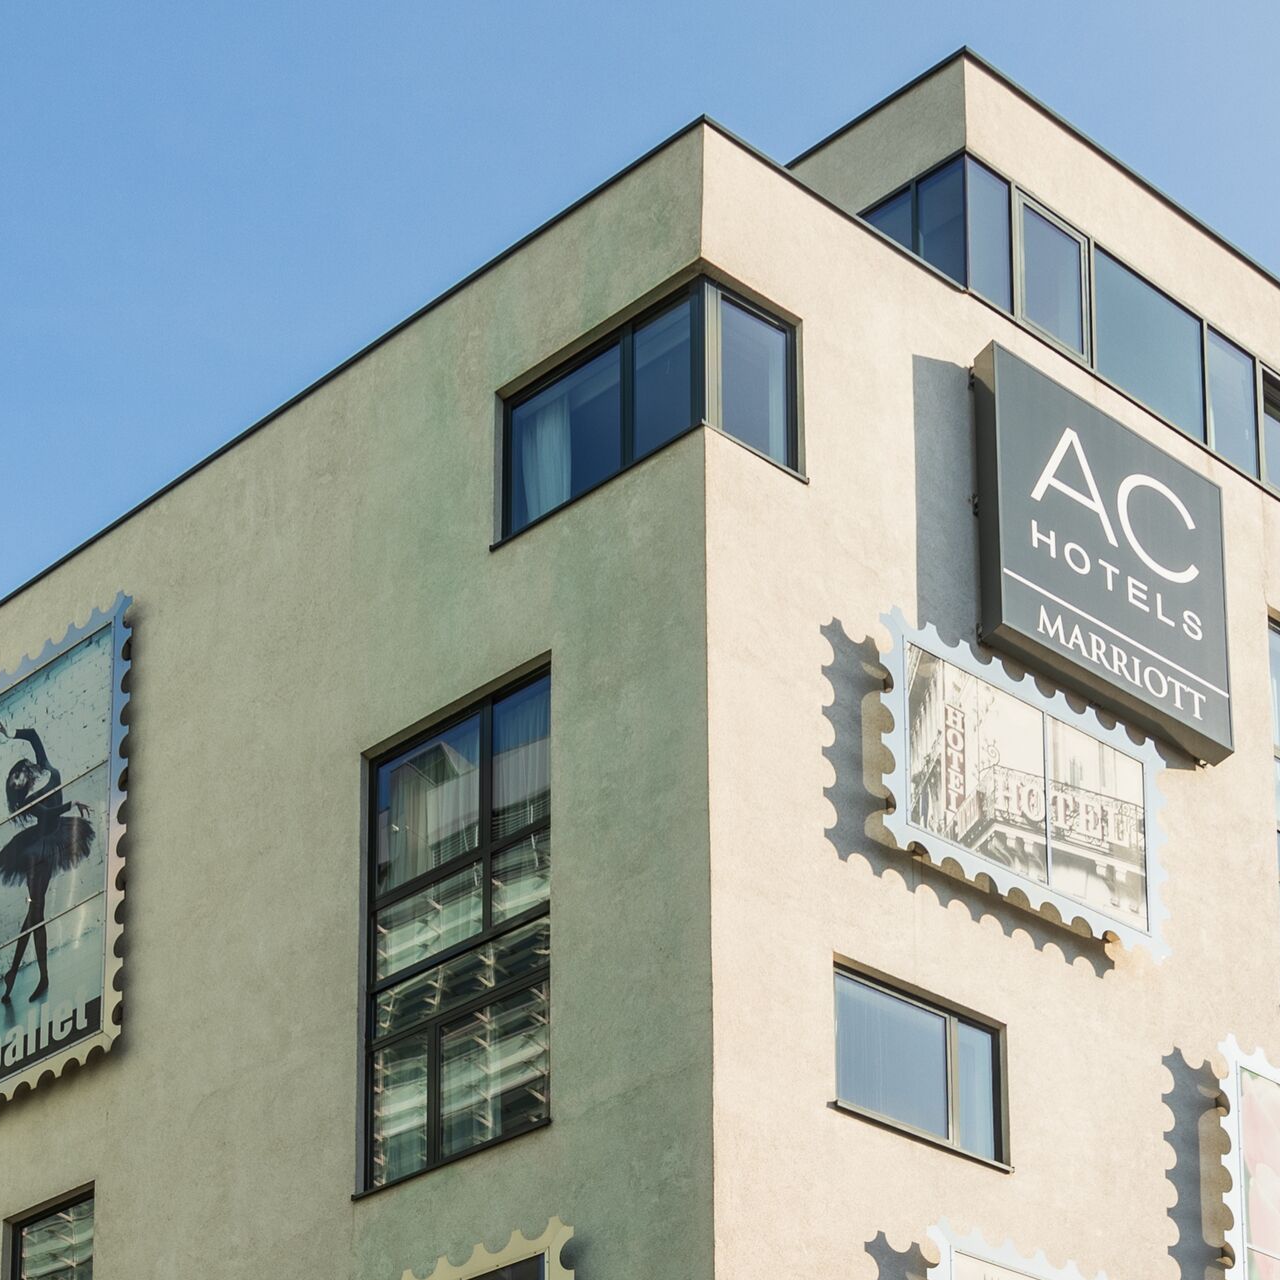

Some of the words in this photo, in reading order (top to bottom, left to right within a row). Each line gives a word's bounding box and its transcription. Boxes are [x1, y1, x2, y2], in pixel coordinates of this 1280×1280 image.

[1030, 427, 1200, 584] AC
[1031, 519, 1203, 641] HOTELS
[1037, 604, 1207, 721] MARRIOTT
